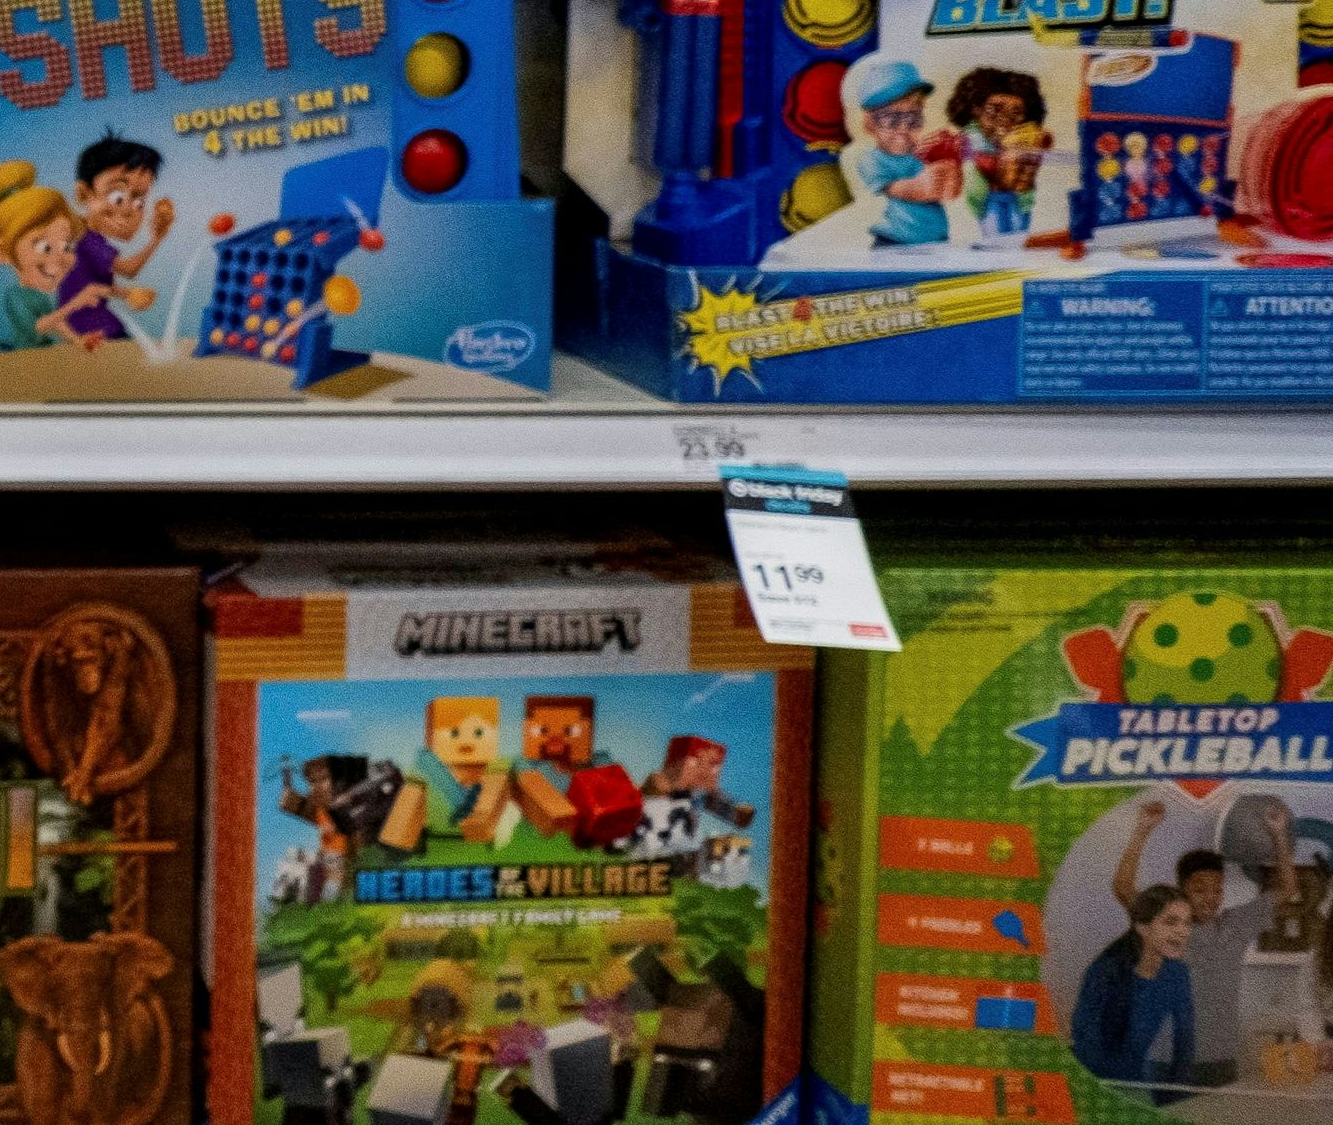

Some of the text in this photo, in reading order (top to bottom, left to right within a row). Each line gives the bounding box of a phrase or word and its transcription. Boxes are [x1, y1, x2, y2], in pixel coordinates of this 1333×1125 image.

[172, 98, 281, 133] BOUNCE
[342, 83, 371, 105] IN
[203, 115, 348, 156] 4 THE WIN!
[394, 607, 645, 658] MINECRAFT
[1118, 707, 1280, 734] TABLETOP
[1061, 734, 1333, 777] PICKLEBALL
[356, 865, 496, 903] HEROES
[527, 861, 673, 898] VILLAGE
